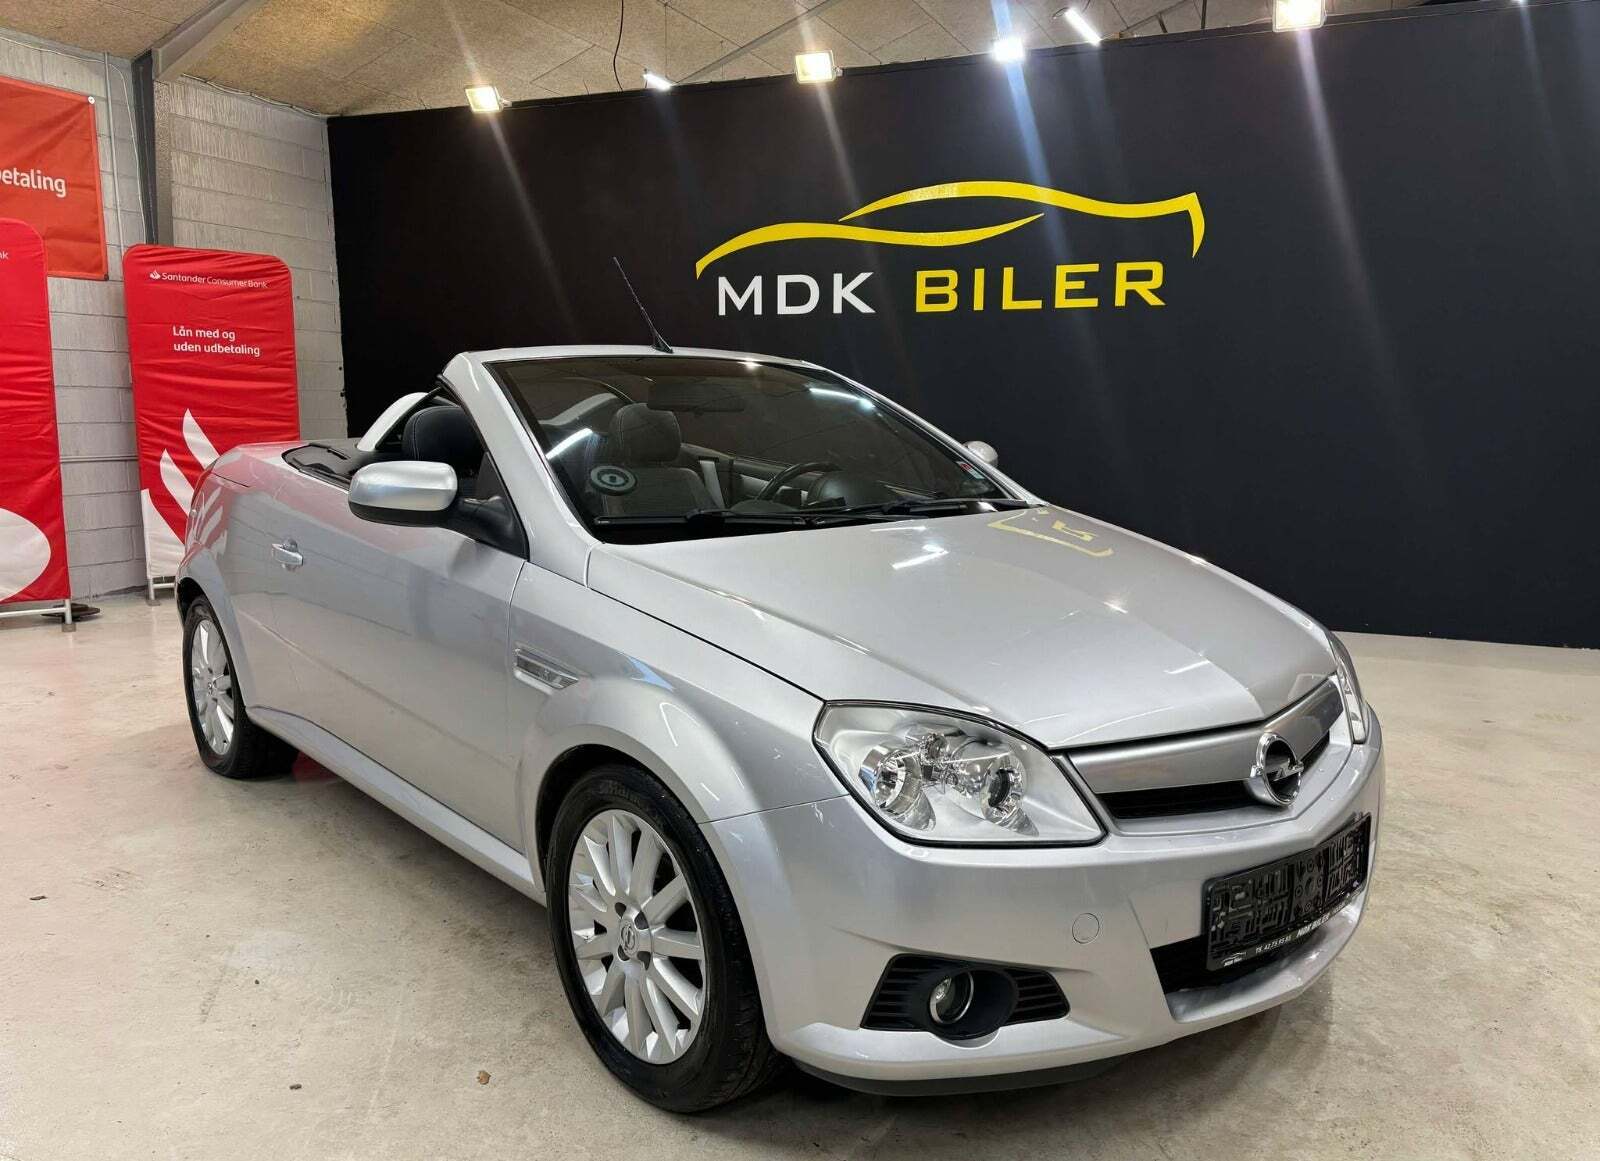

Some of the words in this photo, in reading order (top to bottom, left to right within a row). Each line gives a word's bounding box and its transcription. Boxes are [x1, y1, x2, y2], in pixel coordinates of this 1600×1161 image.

[0, 167, 67, 198] etaling
[162, 272, 206, 284] Santander
[206, 276, 247, 288] Consumer
[247, 280, 269, 289] Bank
[718, 271, 876, 316] MDK
[915, 260, 1167, 313] BILER
[173, 325, 193, 337] Lån
[195, 329, 220, 339] med
[222, 331, 236, 342] og
[174, 342, 201, 352] uden
[204, 344, 261, 358] udbetaling
